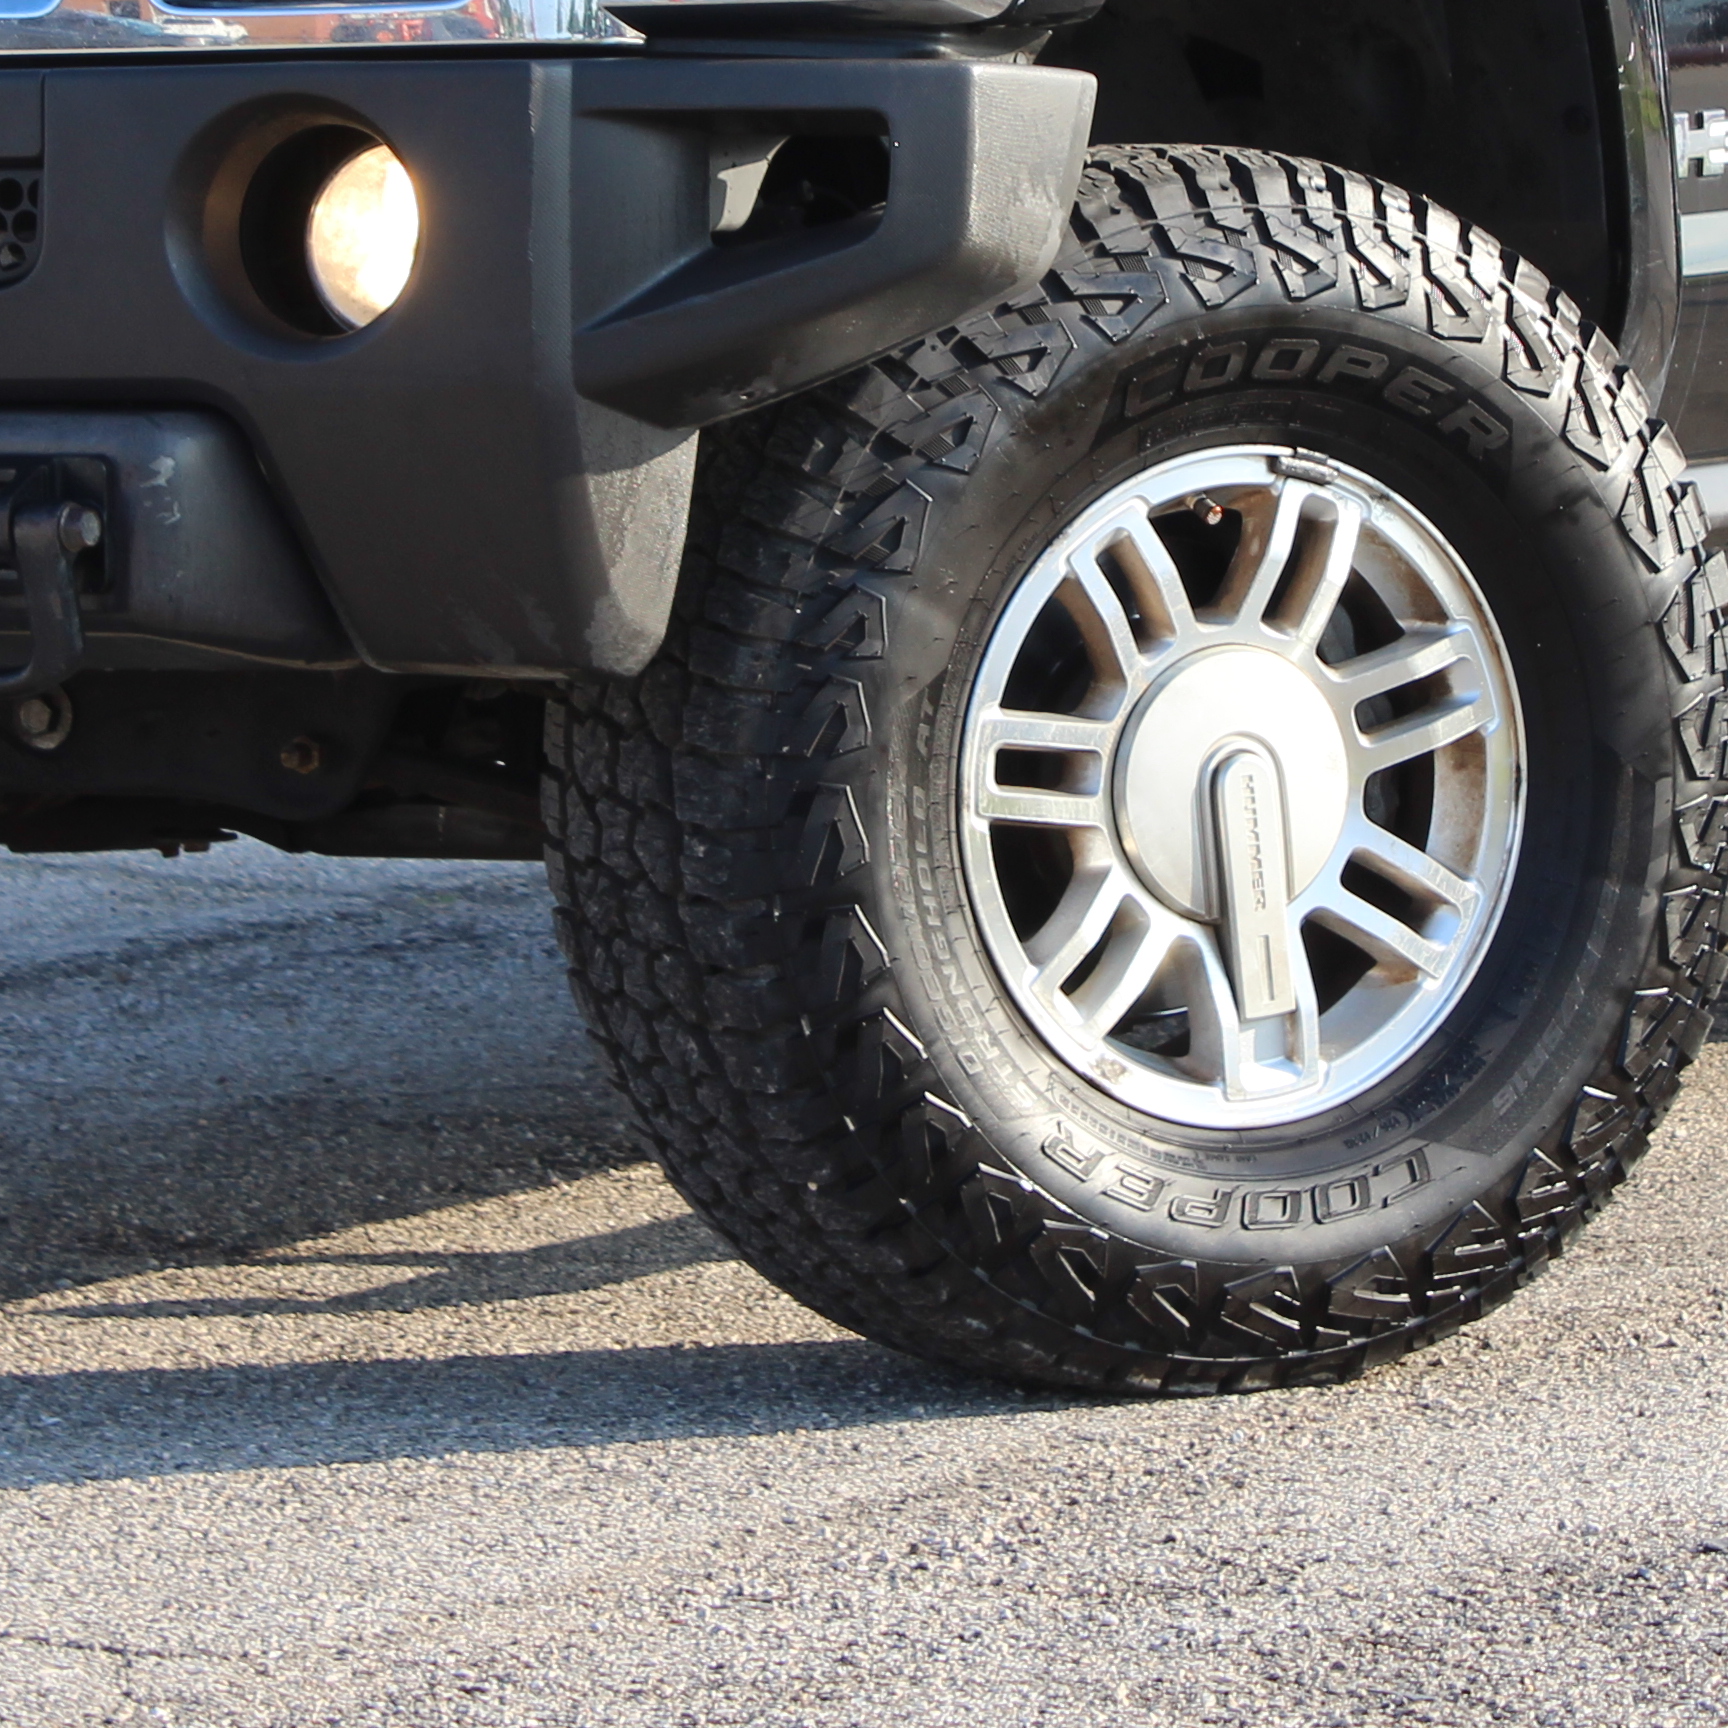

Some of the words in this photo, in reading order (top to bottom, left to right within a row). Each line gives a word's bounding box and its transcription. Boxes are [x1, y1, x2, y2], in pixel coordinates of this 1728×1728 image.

[1122, 337, 1512, 460] COOPER
[1241, 773, 1267, 912] HUMMER
[912, 784, 1038, 1110] STRONGHOLD
[1042, 1118, 1432, 1230] COOPER
